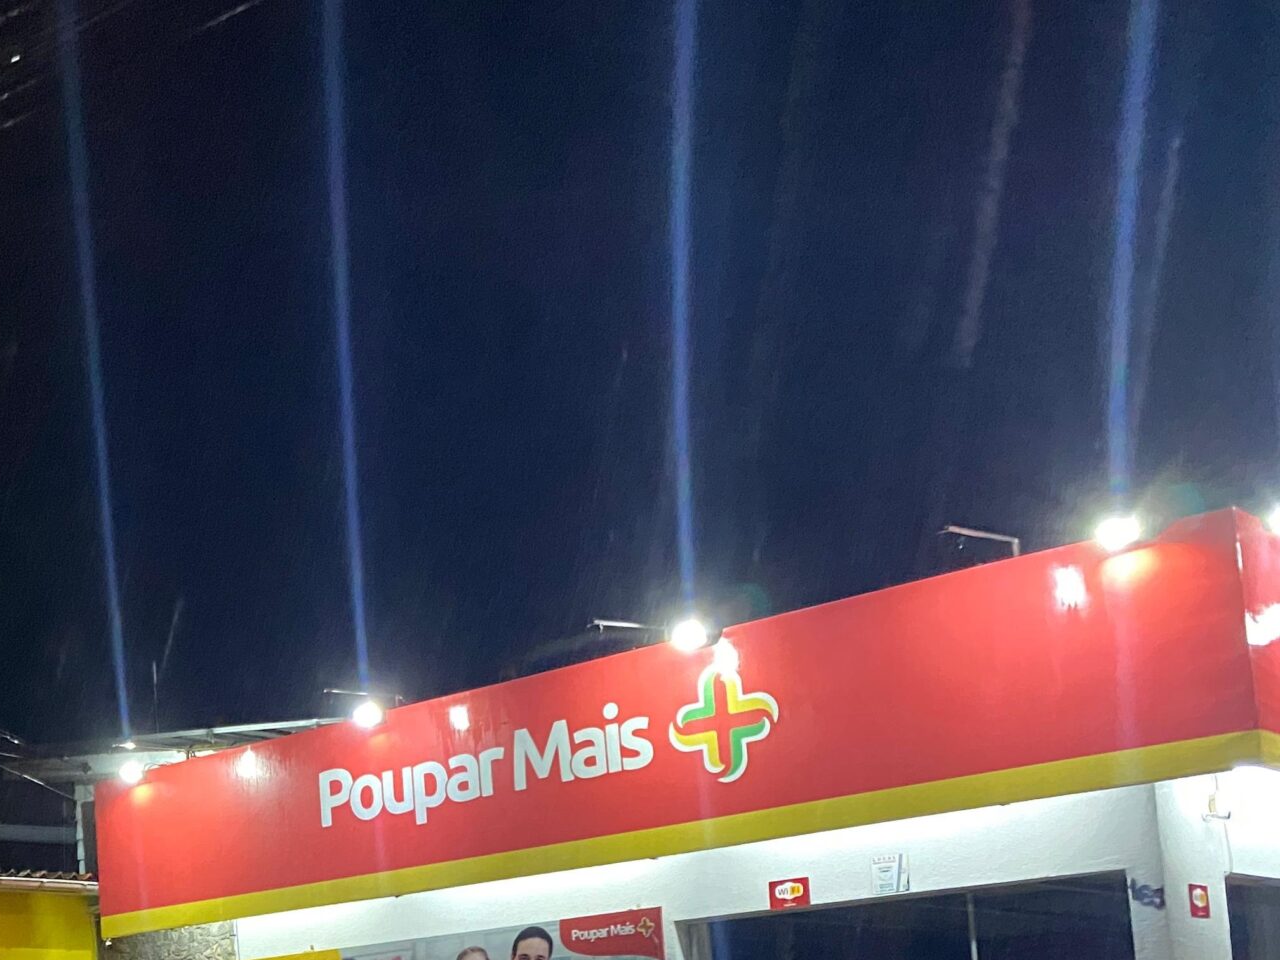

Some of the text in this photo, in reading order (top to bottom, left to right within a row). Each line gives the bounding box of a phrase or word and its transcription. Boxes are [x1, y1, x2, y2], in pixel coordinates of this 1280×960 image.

[318, 702, 654, 828] Poupar Mais
[571, 922, 636, 942] Poupar Mais
